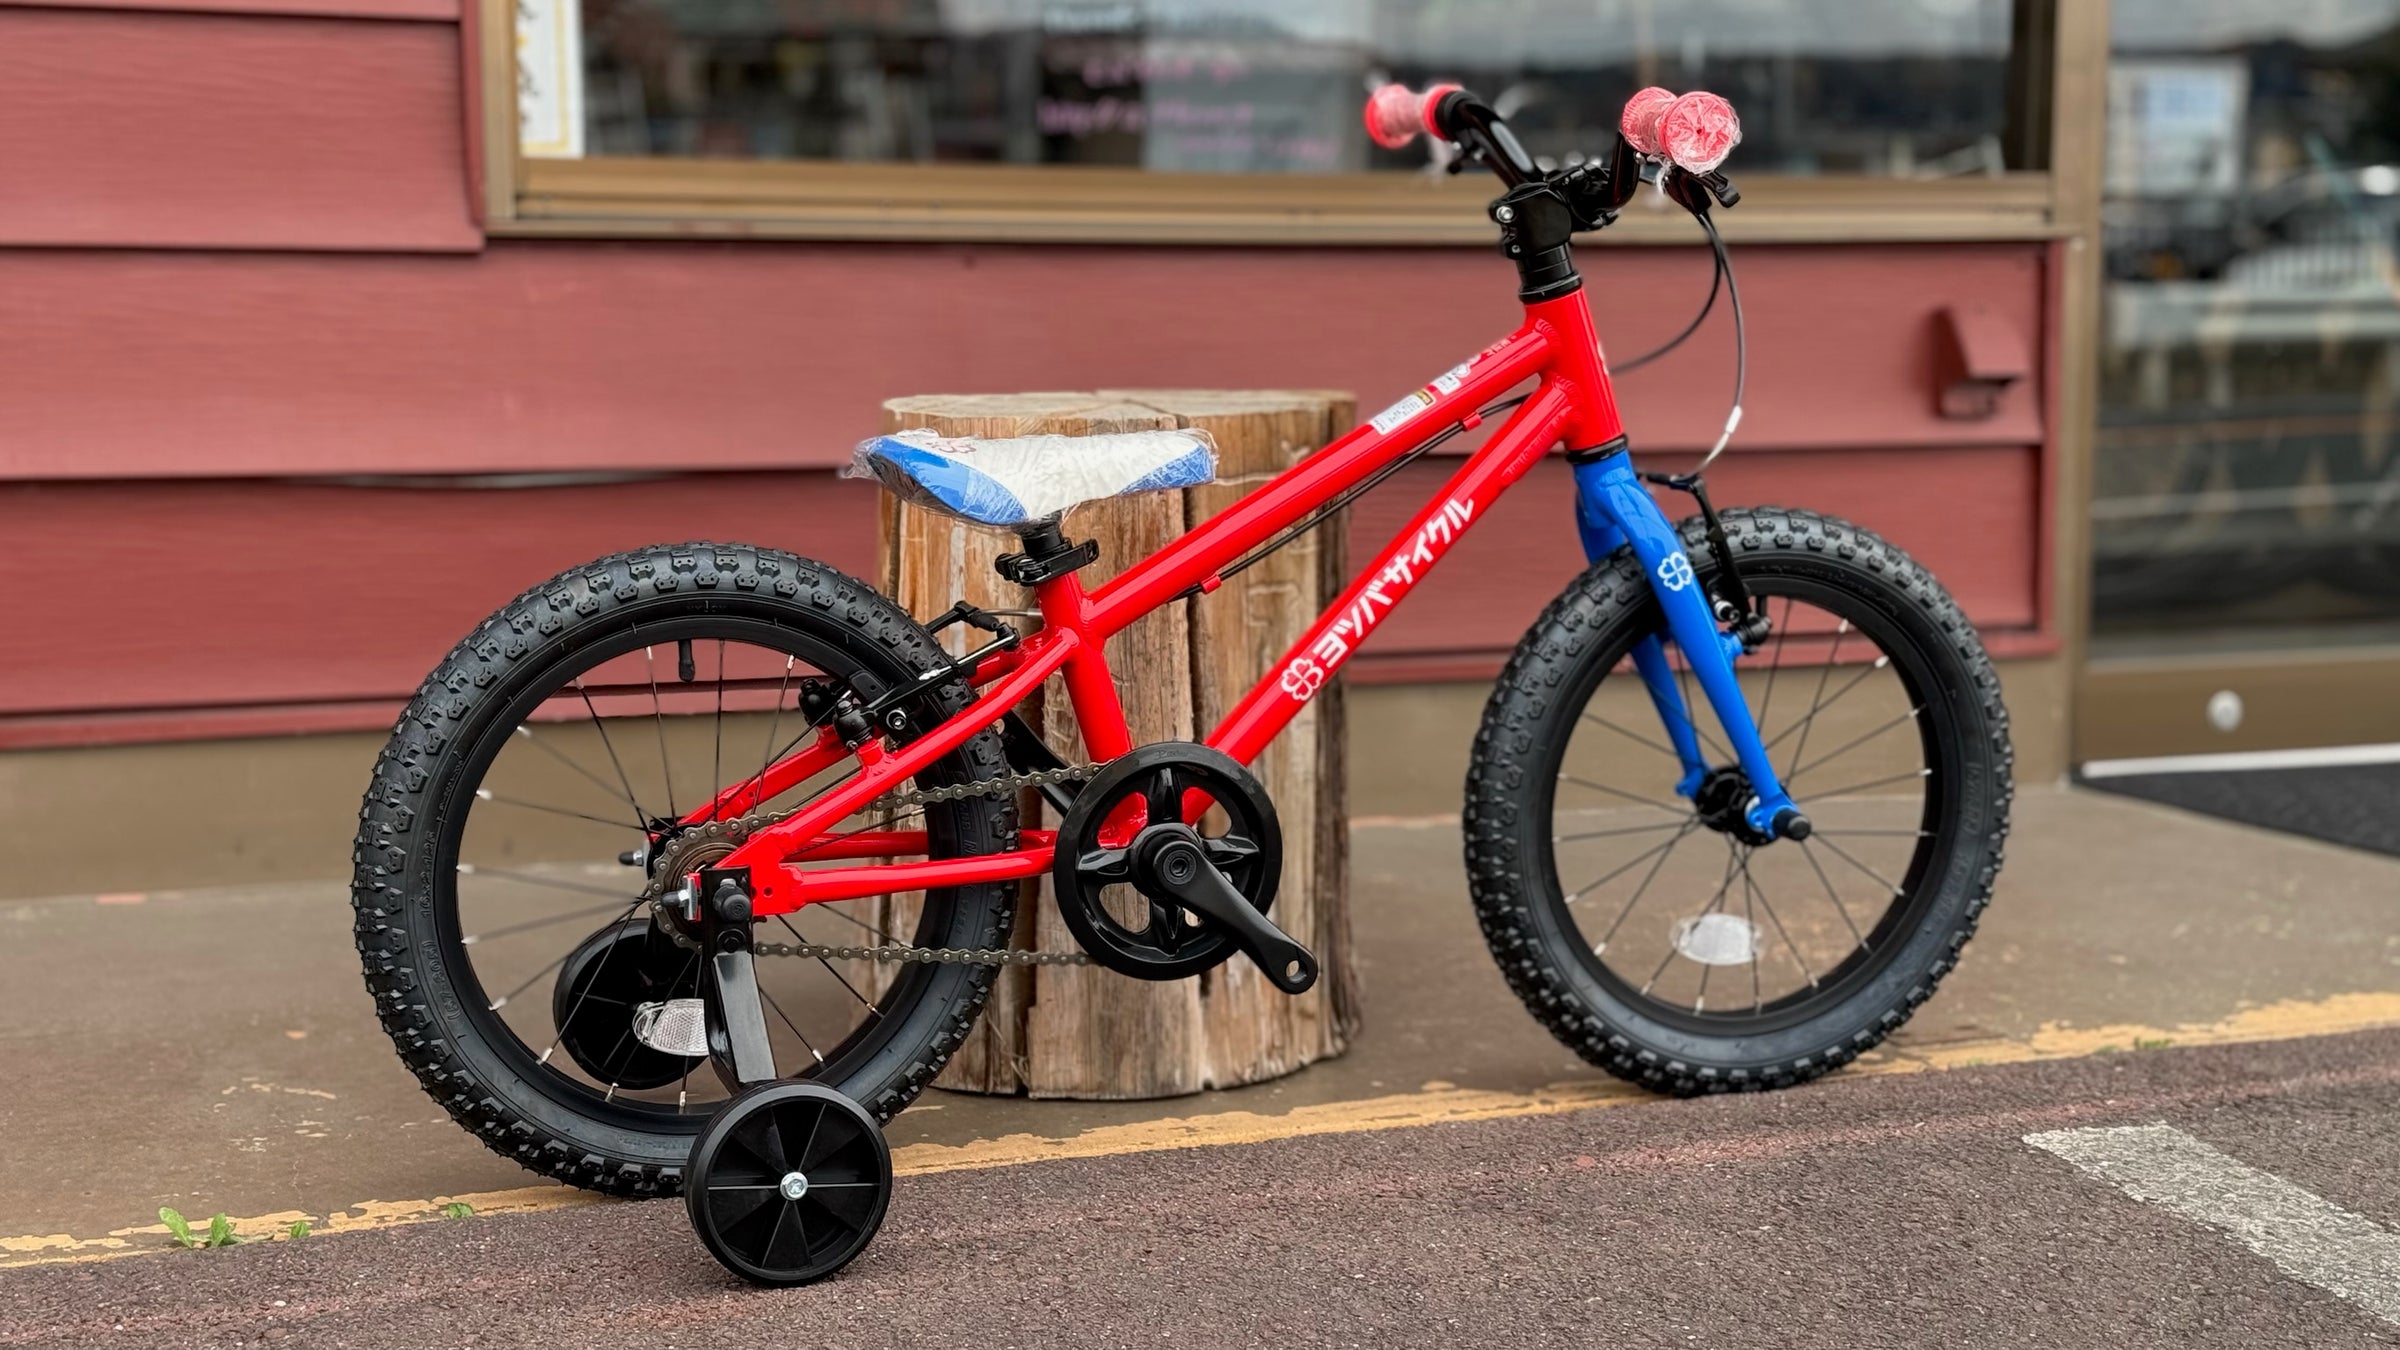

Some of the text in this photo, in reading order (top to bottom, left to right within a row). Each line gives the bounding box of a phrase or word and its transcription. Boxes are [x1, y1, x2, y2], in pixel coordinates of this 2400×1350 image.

[1313, 498, 1474, 667] ヨツバサイクル
